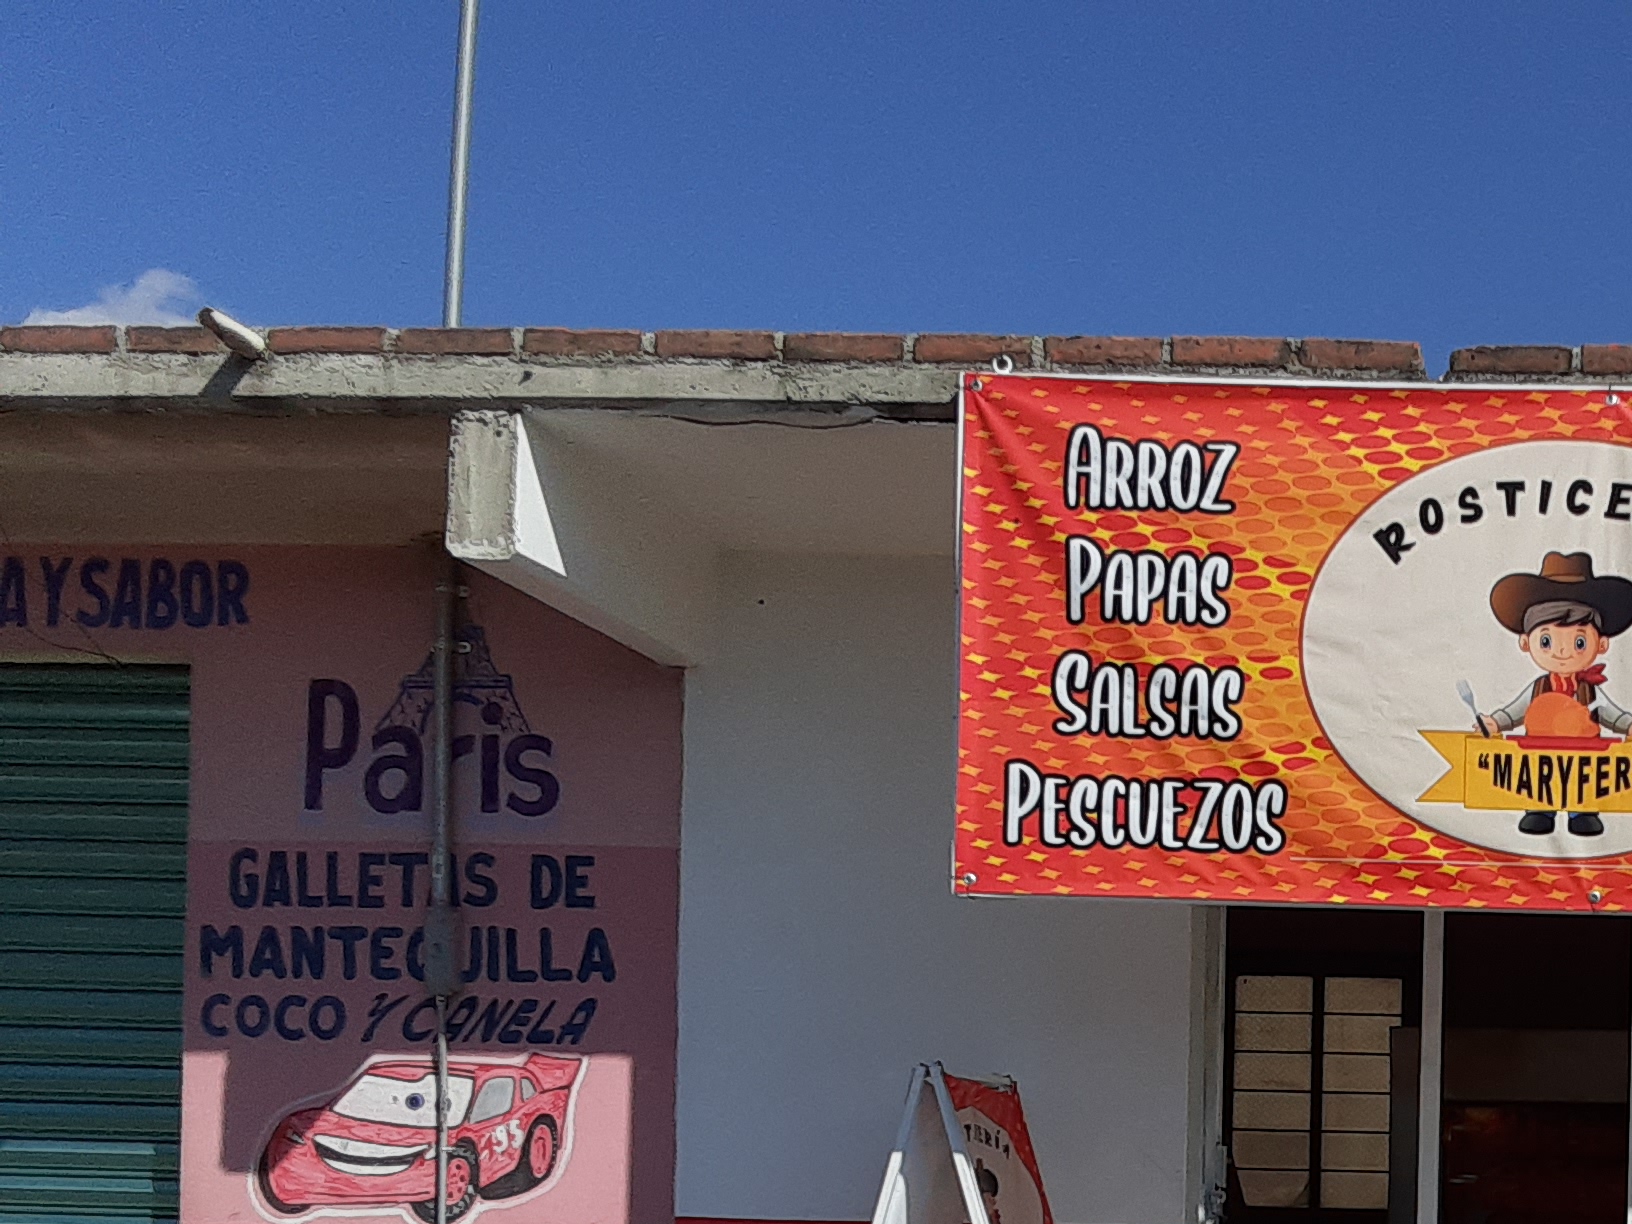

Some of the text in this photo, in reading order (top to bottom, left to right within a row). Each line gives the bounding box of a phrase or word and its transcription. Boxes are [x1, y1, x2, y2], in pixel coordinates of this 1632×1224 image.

[1065, 423, 1240, 514] ARROZ
[39, 555, 74, 627] Y
[76, 557, 250, 630] SABOR
[1066, 536, 1233, 627] PAPAS
[1051, 651, 1244, 739] SALSAS
[1002, 759, 1287, 854] PESCUEZOS
[530, 853, 597, 909] DE
[200, 991, 598, 1045] COCO Y CANELA
